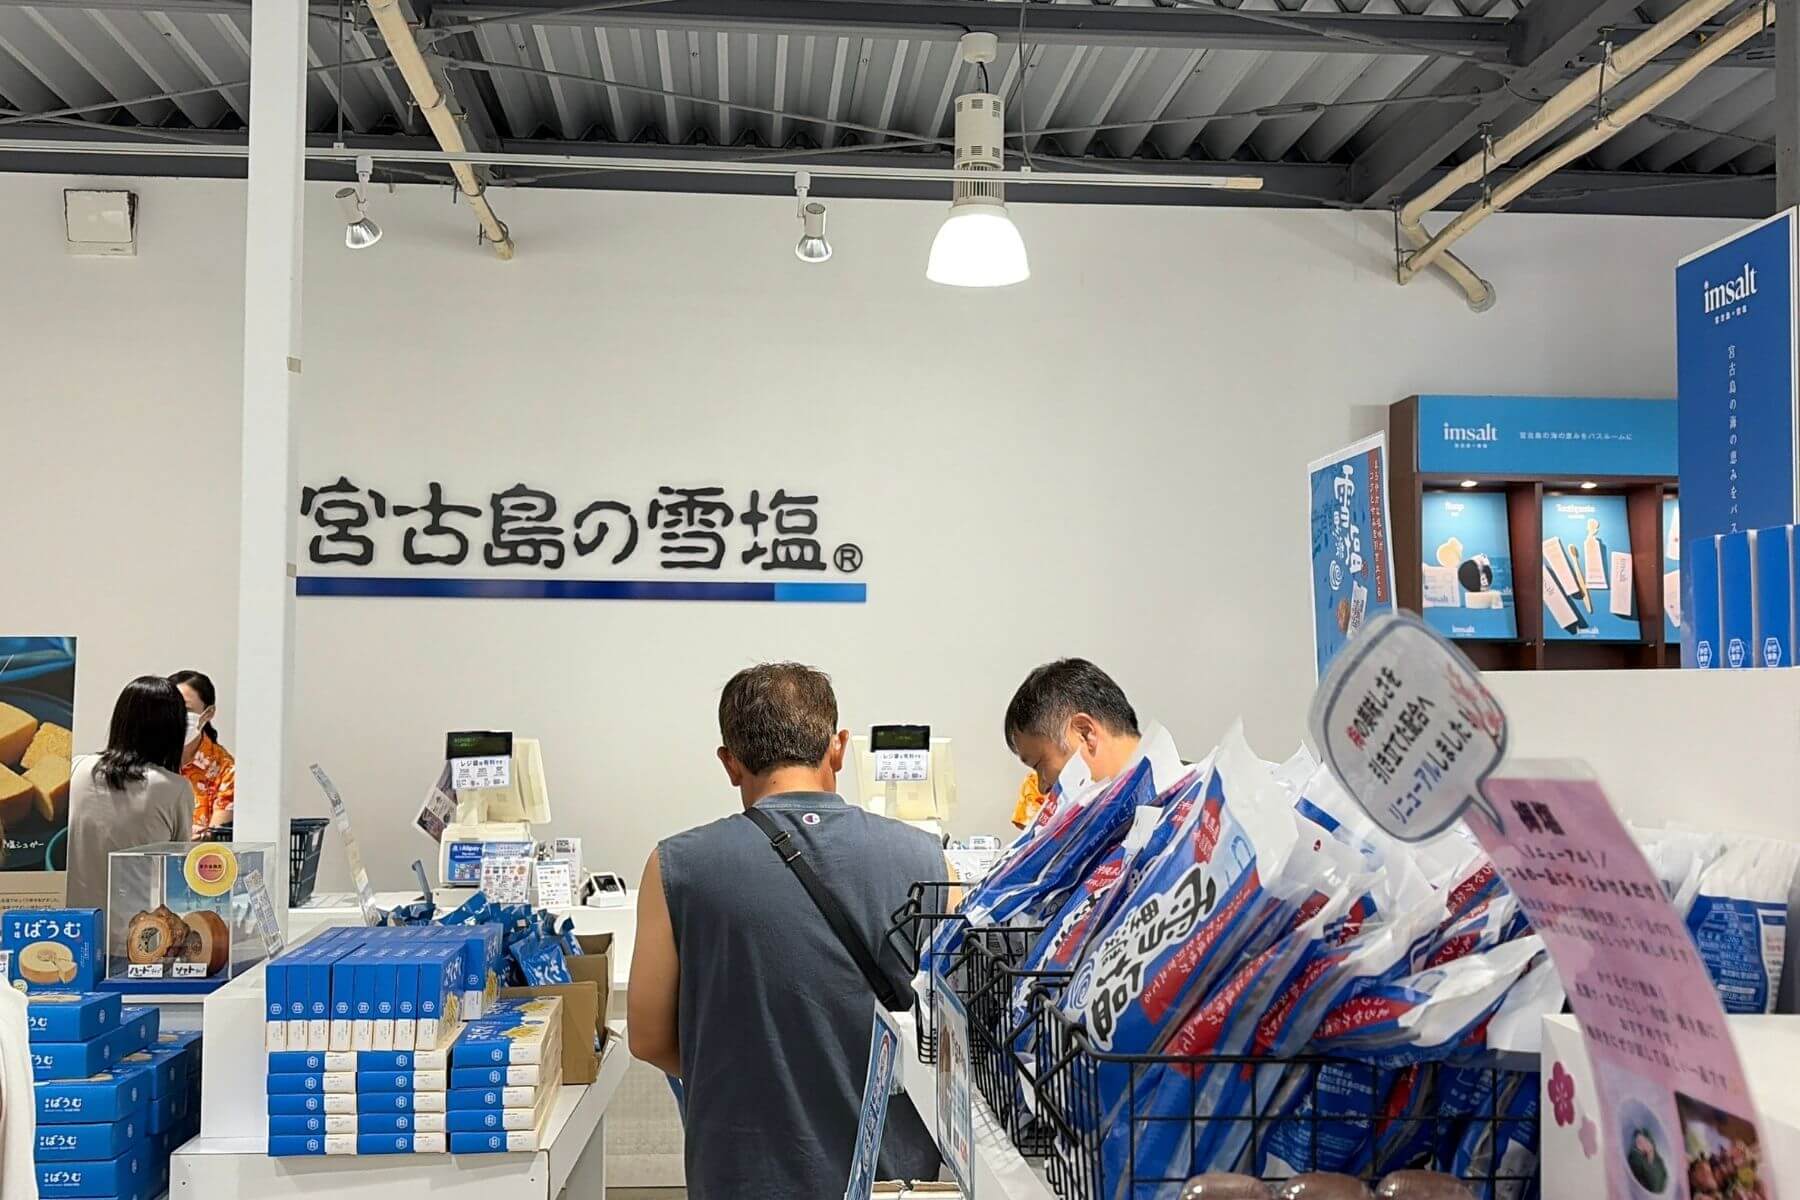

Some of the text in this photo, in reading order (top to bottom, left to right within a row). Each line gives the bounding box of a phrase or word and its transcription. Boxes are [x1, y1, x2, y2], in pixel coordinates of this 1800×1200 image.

[1704, 262, 1758, 313] imsalt
[1443, 422, 1498, 441] imsalt
[300, 475, 827, 571] 宮古島の雪塩
[1368, 695, 1435, 785] 引き立てた配合へ
[24, 919, 81, 939] ばうむ
[1092, 868, 1216, 1042] 雪塩
[31, 1054, 54, 1065] うむ
[50, 1098, 82, 1109] ばうむ
[46, 1135, 77, 1146] ばうむ
[50, 1172, 82, 1183] ばうむ
